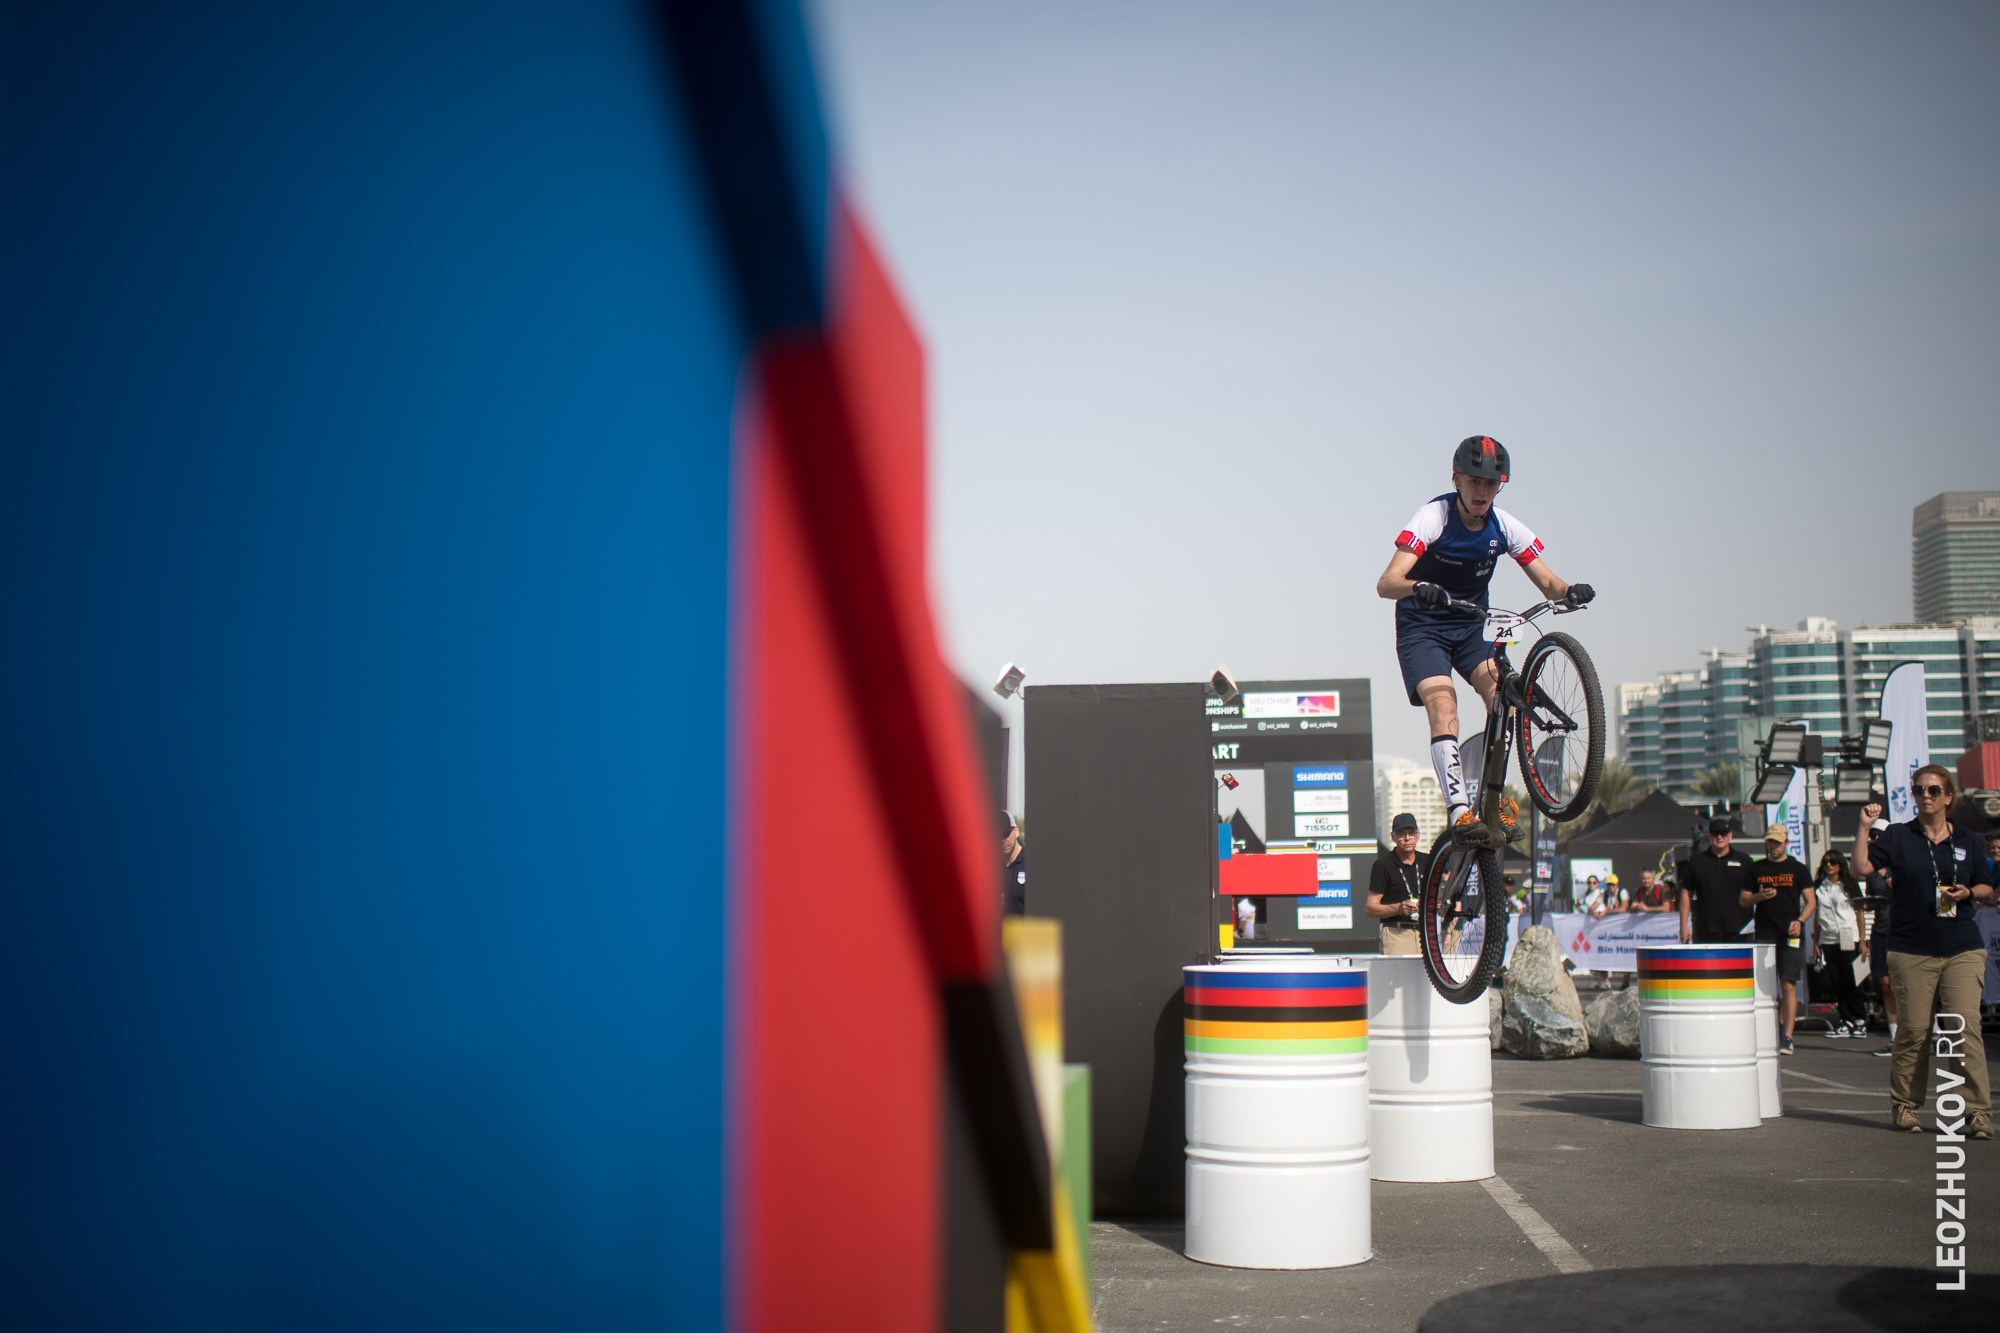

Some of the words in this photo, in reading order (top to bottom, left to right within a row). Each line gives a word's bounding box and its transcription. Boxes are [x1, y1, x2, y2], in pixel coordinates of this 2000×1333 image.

[1205, 698, 1224, 707] ING
[1296, 772, 1344, 782] SHIMANO
[1304, 824, 1340, 832] TISSOT
[1597, 946, 1613, 954] Bin
